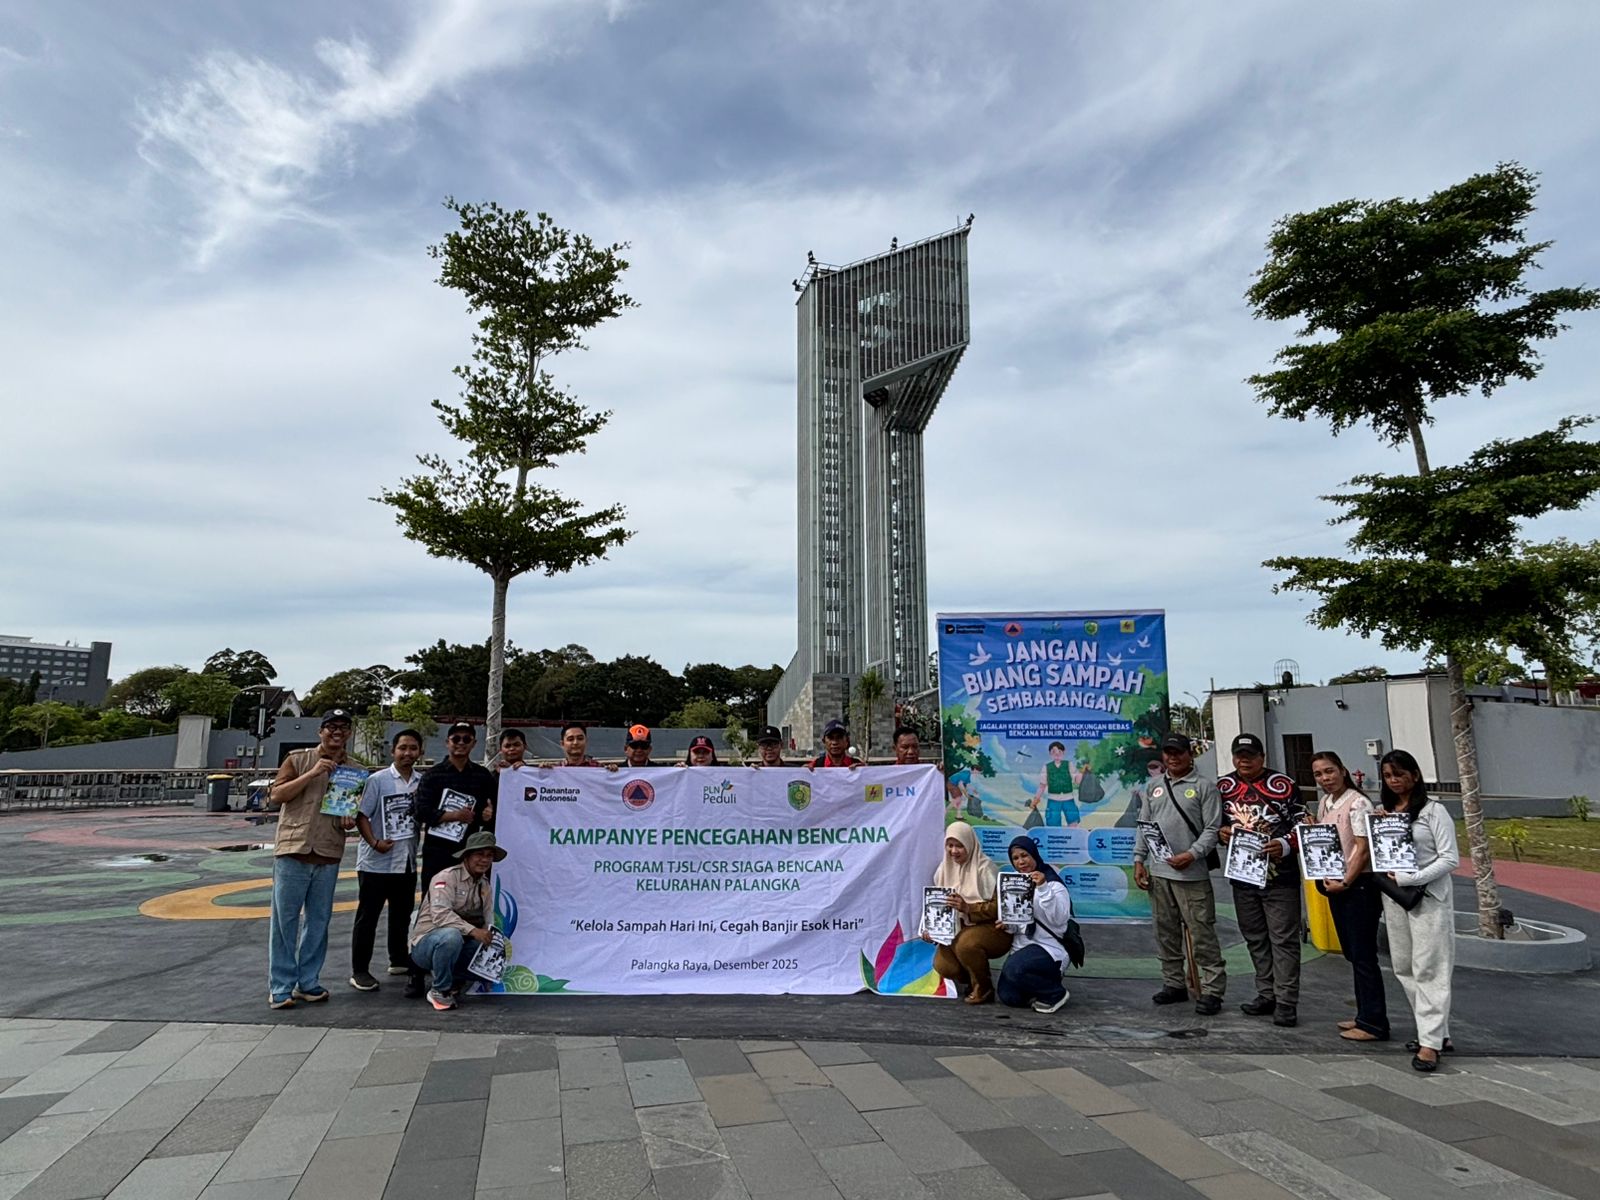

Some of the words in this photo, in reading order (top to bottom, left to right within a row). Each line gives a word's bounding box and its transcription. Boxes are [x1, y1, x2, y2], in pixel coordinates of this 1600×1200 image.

[1006, 639, 1098, 664] JANGAN
[962, 665, 1041, 696] BUANG
[1046, 664, 1144, 695] SAMPAH
[986, 690, 1122, 714] SEMBARANGAN
[540, 787, 581, 795] Danantara
[703, 786, 720, 794] PLN
[885, 786, 915, 797] PLN
[539, 794, 578, 802] Indonesia
[703, 794, 736, 805] Peduli
[550, 828, 657, 845] KAMPANYE
[661, 828, 793, 845] PENCEGAHAN
[797, 826, 890, 844] BENCANA
[1095, 838, 1107, 849] 3.
[594, 860, 664, 873] PROGRAM
[667, 860, 728, 874] TJSL/CSR
[731, 860, 774, 873] SIAGA
[777, 860, 844, 873] BENCANA
[636, 879, 722, 891] KELURAHAN
[724, 878, 801, 891] PALANGKA
[1064, 875, 1076, 886] 5.
[570, 919, 614, 932] “Kelola
[617, 919, 667, 934] Sampah
[670, 920, 695, 932] Hari
[698, 920, 717, 933] Ini,
[720, 920, 759, 934] Cegah
[762, 919, 798, 935] Banjir
[801, 919, 830, 931] Esok
[833, 918, 864, 931] Hari”
[631, 959, 680, 972] Palangka
[682, 959, 711, 972] Raya,
[713, 959, 769, 970] Desember
[772, 959, 798, 970] 2025
